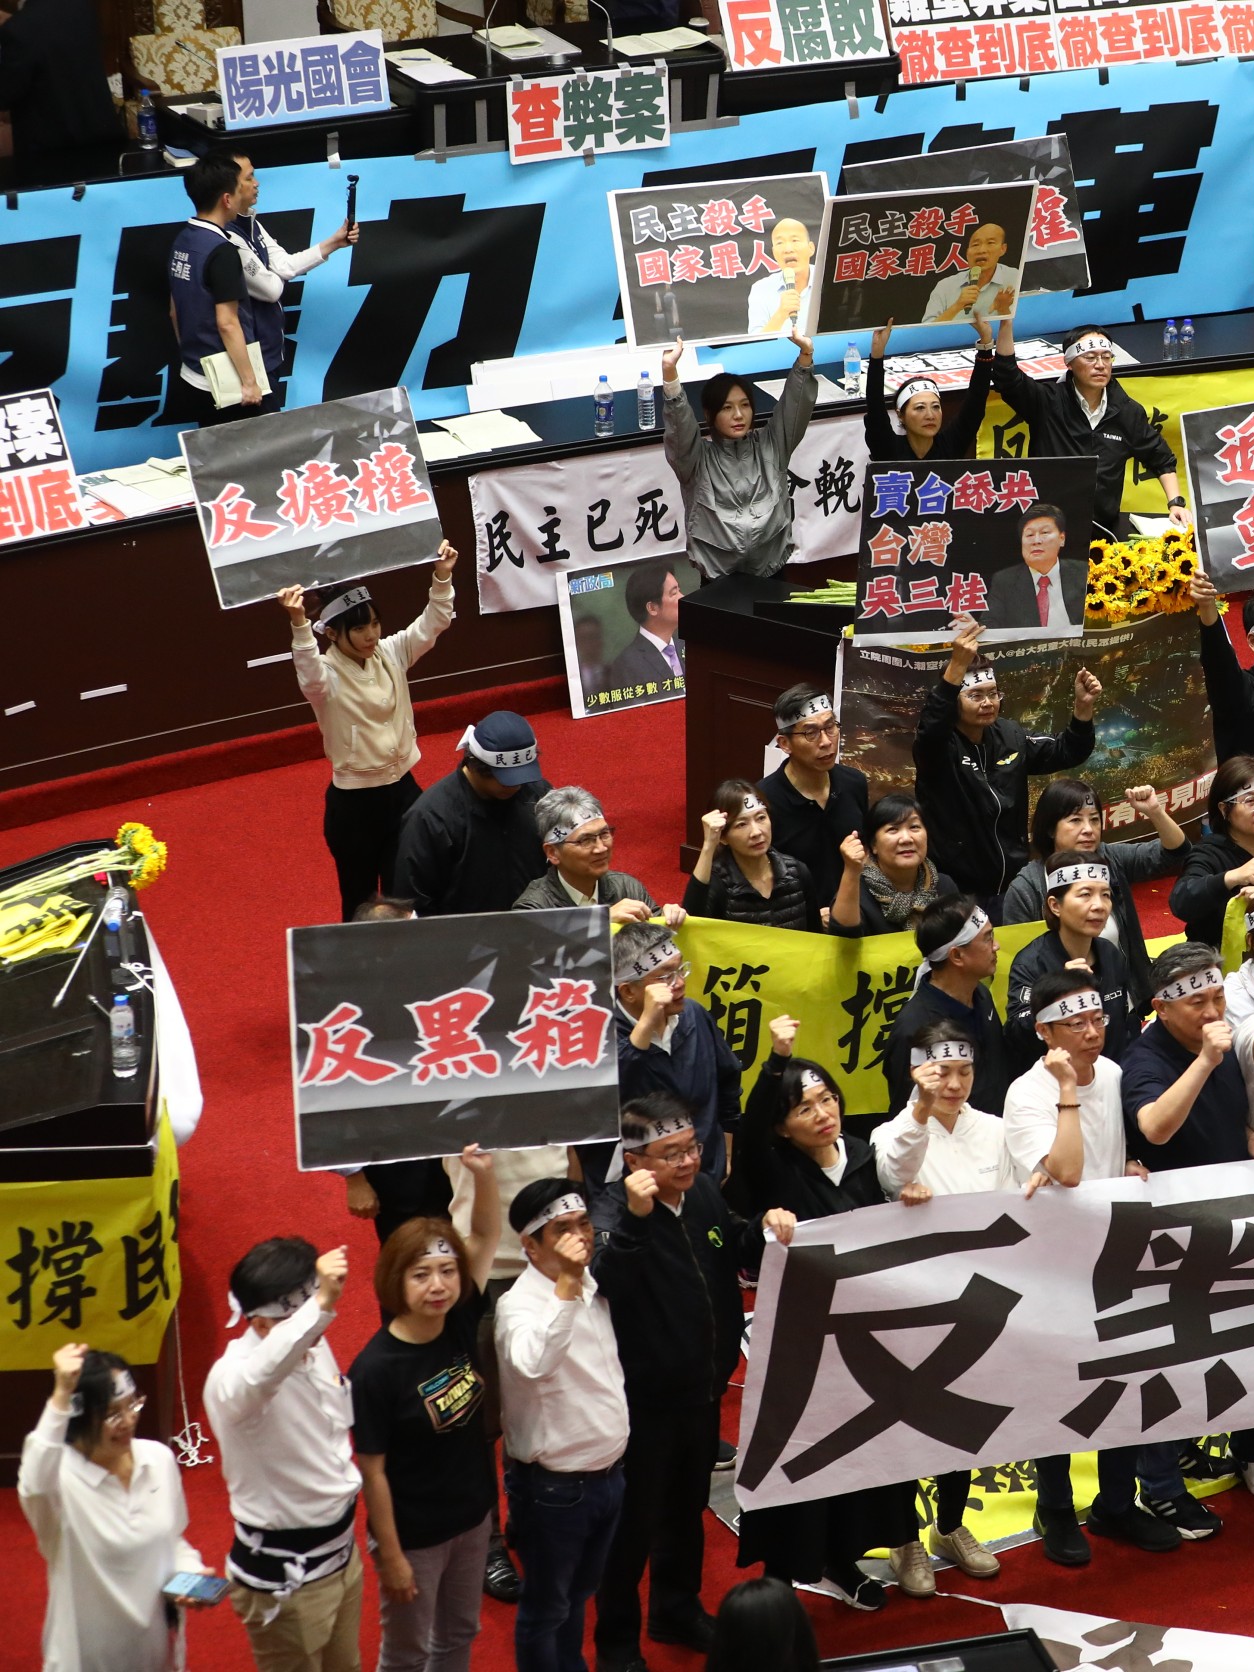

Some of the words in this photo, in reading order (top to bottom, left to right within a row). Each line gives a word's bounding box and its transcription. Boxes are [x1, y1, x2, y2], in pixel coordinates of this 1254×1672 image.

[725, 0, 886, 68] 反腐敗
[895, 20, 1058, 84] 徹查到底
[1060, 4, 1222, 67] 徹查到底
[224, 40, 386, 121] 陽光國會
[512, 72, 667, 154] 查弊案
[632, 194, 775, 245] 民主殺手
[839, 202, 979, 247] 民主殺手
[636, 240, 781, 287] 國家罪人
[833, 244, 968, 284] 國家罪人
[1075, 339, 1112, 353] 民主已
[0, 397, 64, 468] 案
[207, 443, 431, 548] 反擴權
[871, 470, 1040, 519] 賣台舔共
[484, 488, 681, 574] 民主已死
[867, 524, 952, 571] 台灣
[861, 574, 989, 619] 吳三桂
[587, 681, 658, 709] 少數服從多數
[633, 940, 677, 976] 民主已
[300, 979, 612, 1085] 反黑箱
[925, 1043, 973, 1062] 民主已
